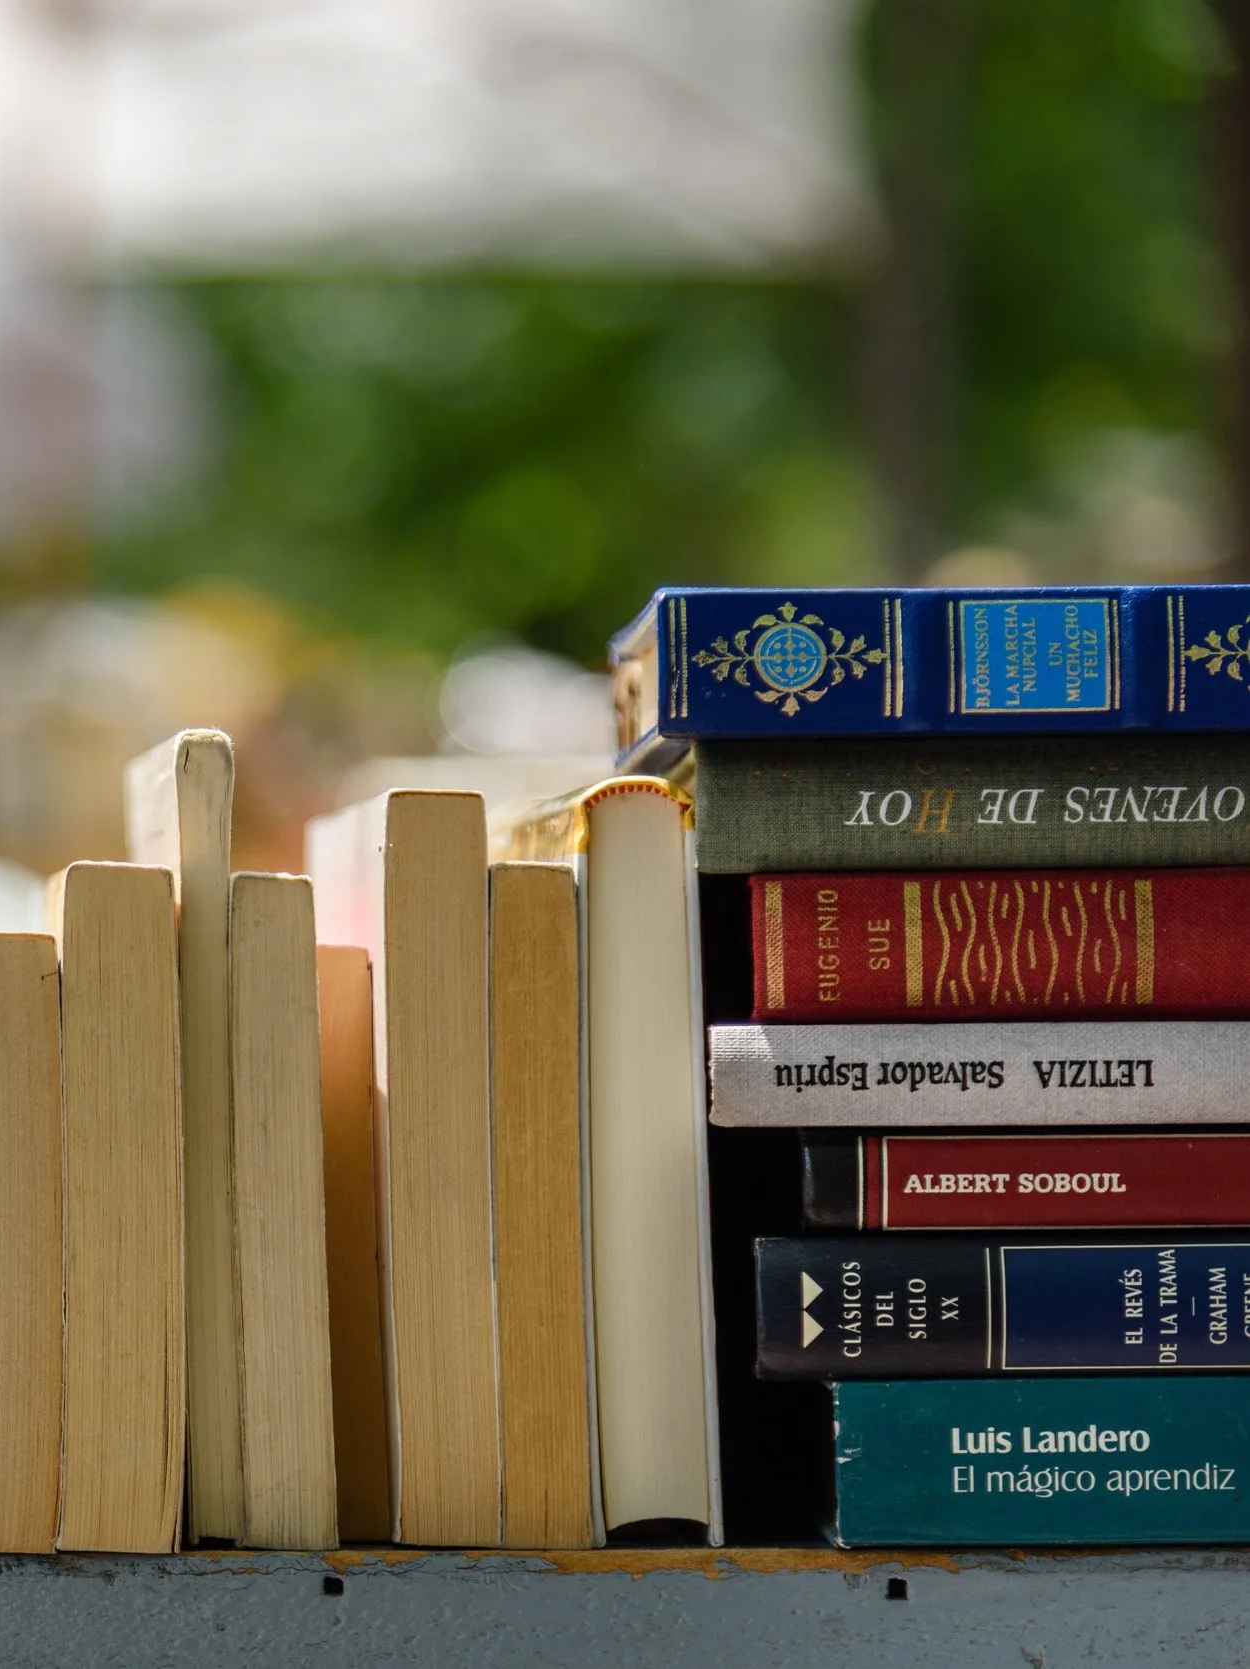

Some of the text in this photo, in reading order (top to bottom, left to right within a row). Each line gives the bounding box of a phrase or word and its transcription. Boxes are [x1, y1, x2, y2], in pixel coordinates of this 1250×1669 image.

[971, 608, 991, 707] BJÖRNSSON
[1005, 604, 1020, 706] LA MARCHA
[1021, 617, 1037, 692] NUPCIAL
[1048, 641, 1063, 666] UN
[1065, 604, 1080, 703] MUCHACHO
[1082, 629, 1099, 679] FELIZ
[844, 785, 1250, 834] OVENES DE HOY
[818, 890, 839, 1001] EUGENIO
[868, 919, 890, 970] SUE
[774, 1056, 1004, 1093] Salvador Espriu
[1033, 1060, 1154, 1088] LETIZIA
[904, 1173, 1126, 1193] ALBERT SOBOUL
[839, 1262, 861, 1357] CLÁSICOS
[875, 1291, 894, 1327] DEL
[909, 1279, 926, 1338] SIGLO
[942, 1297, 958, 1319] XX
[1119, 1269, 1143, 1345] EL REVÉS
[1155, 1248, 1178, 1362] DE LA TRAMA
[1209, 1268, 1227, 1344] GRAHAM
[953, 1425, 1150, 1454] Luis Landero
[954, 1463, 1235, 1497] El mágico aprendiz
